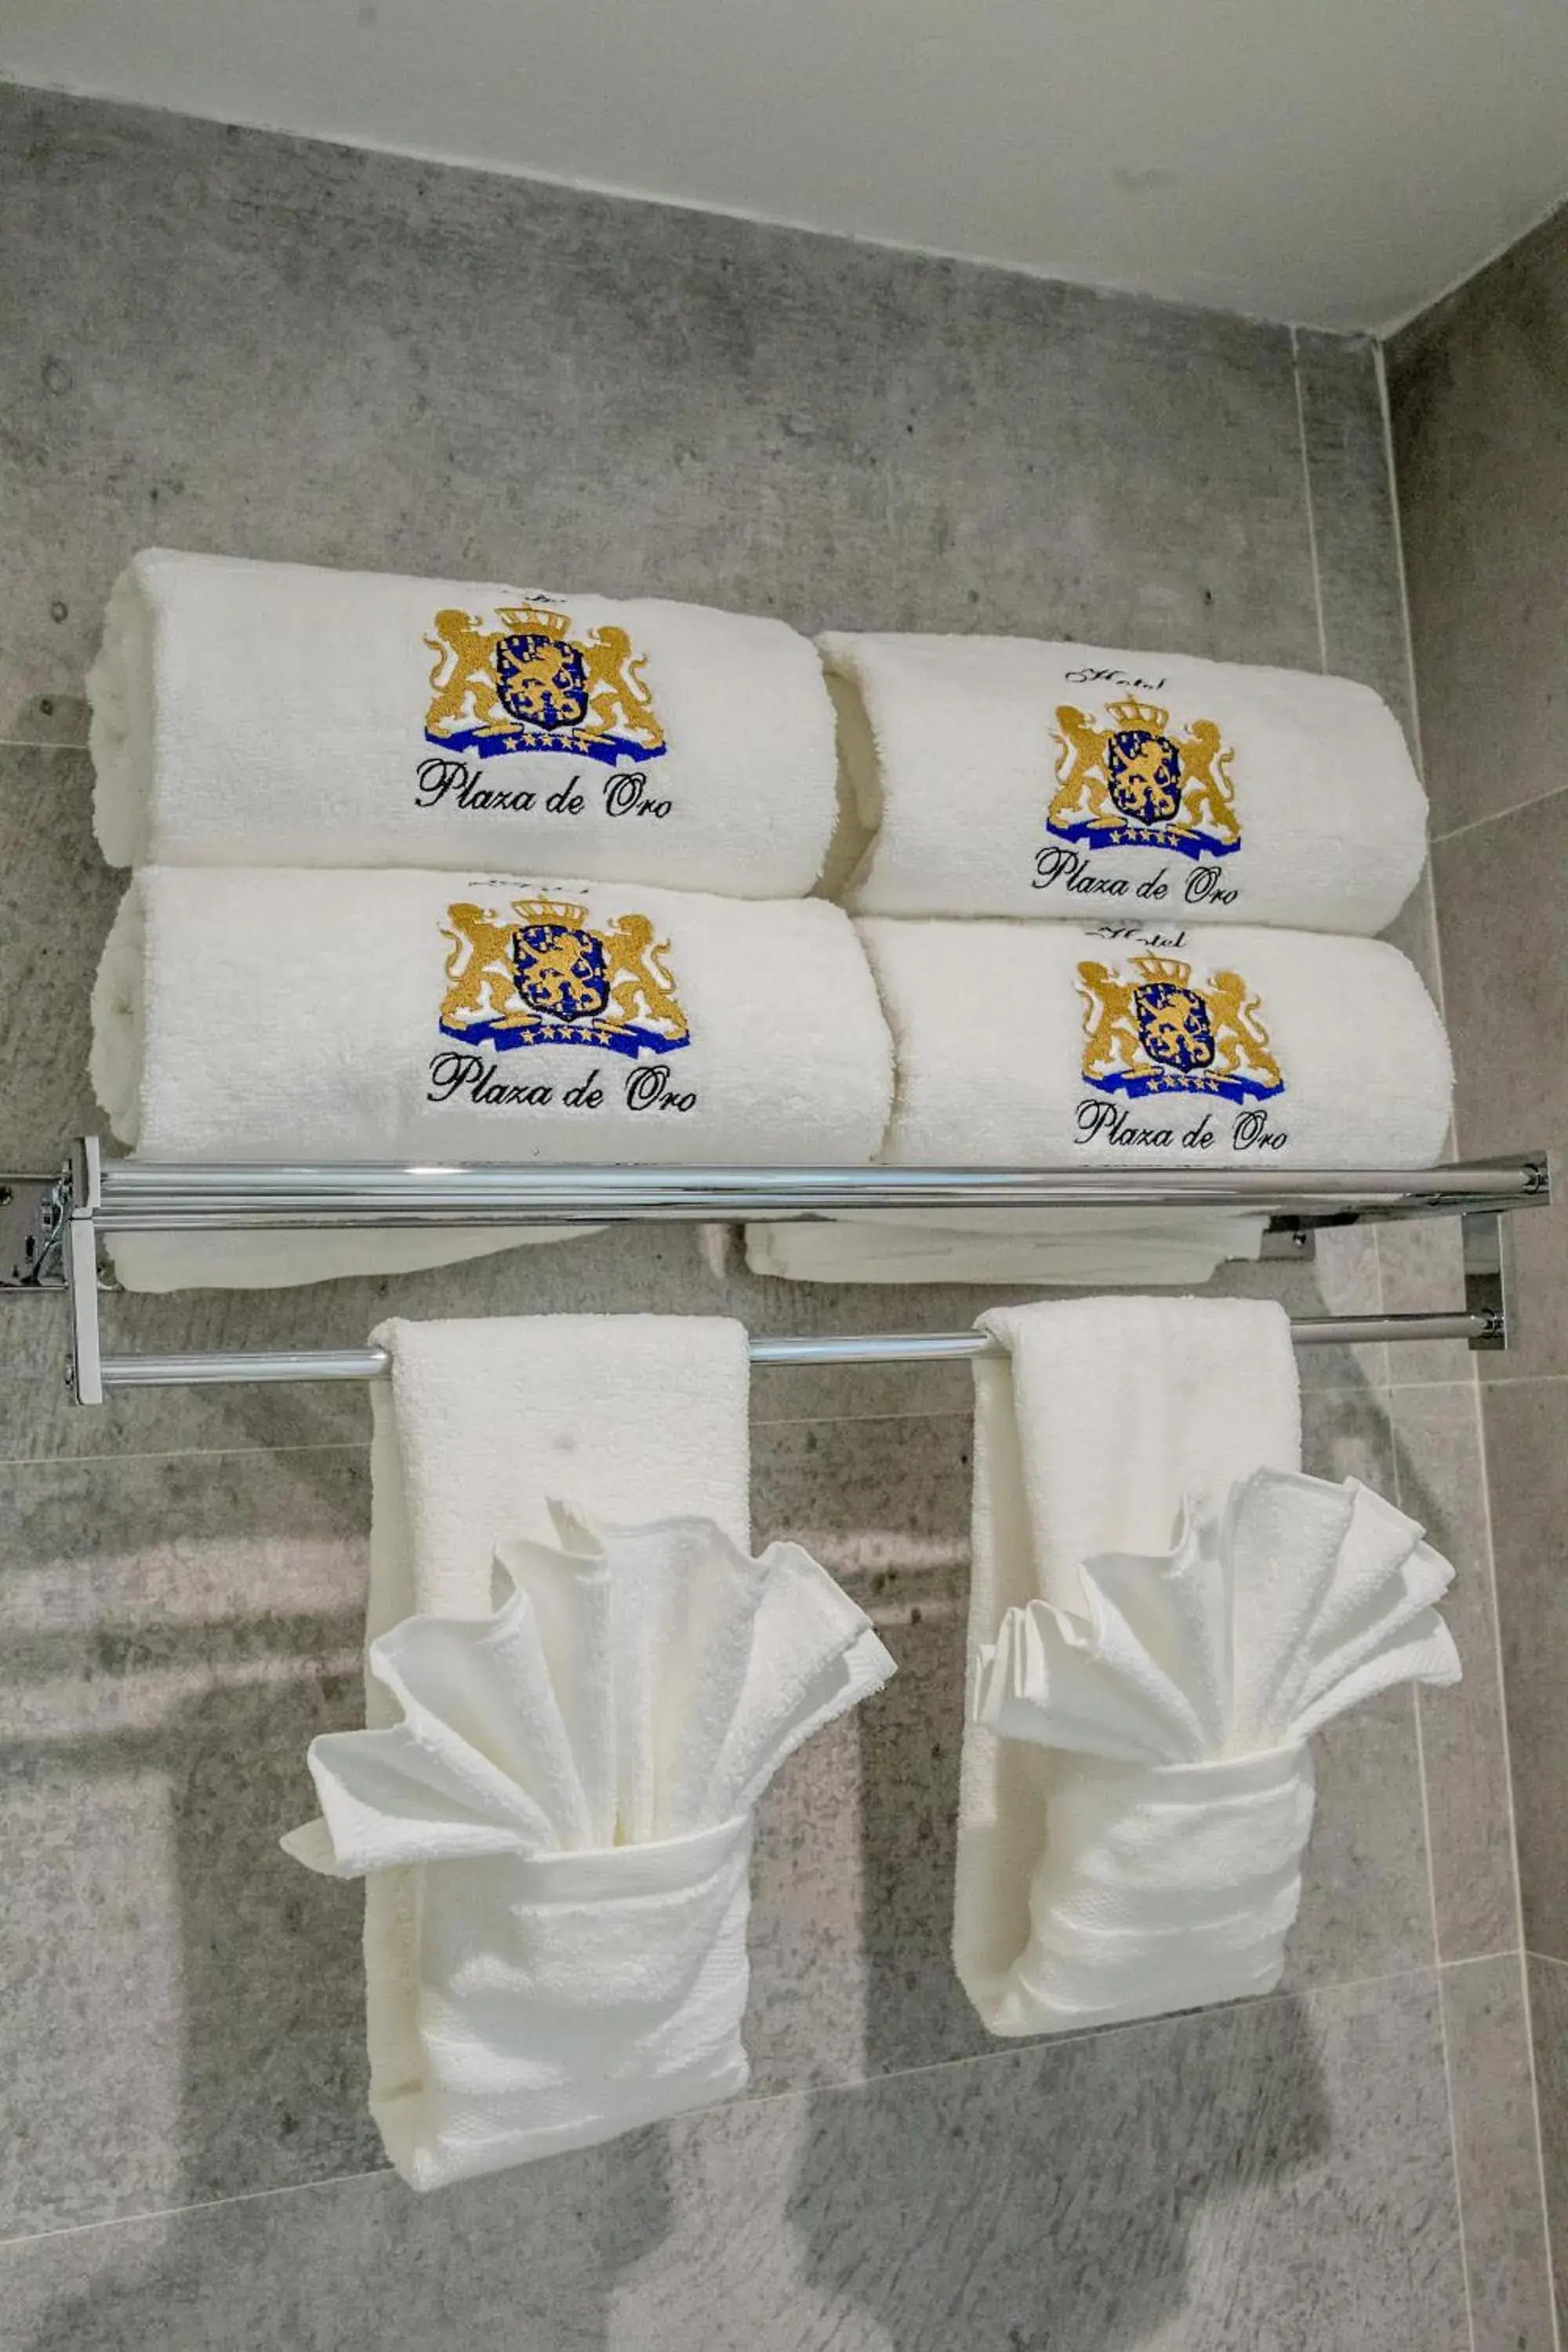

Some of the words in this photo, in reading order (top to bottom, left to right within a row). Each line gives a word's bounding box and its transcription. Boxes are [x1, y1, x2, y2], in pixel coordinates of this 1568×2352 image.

[416, 758, 535, 811] Plaza
[546, 775, 585, 815] de
[603, 772, 672, 818] Oro
[1031, 846, 1130, 897] Plaza
[1136, 867, 1168, 900] de
[1184, 866, 1240, 906] Oro
[427, 1051, 552, 1107] Plaza
[562, 1069, 604, 1109] de
[626, 1065, 697, 1112] Oro
[1074, 1098, 1174, 1147] Plaza
[1181, 1113, 1215, 1149] de
[1233, 1109, 1289, 1151] Oro
